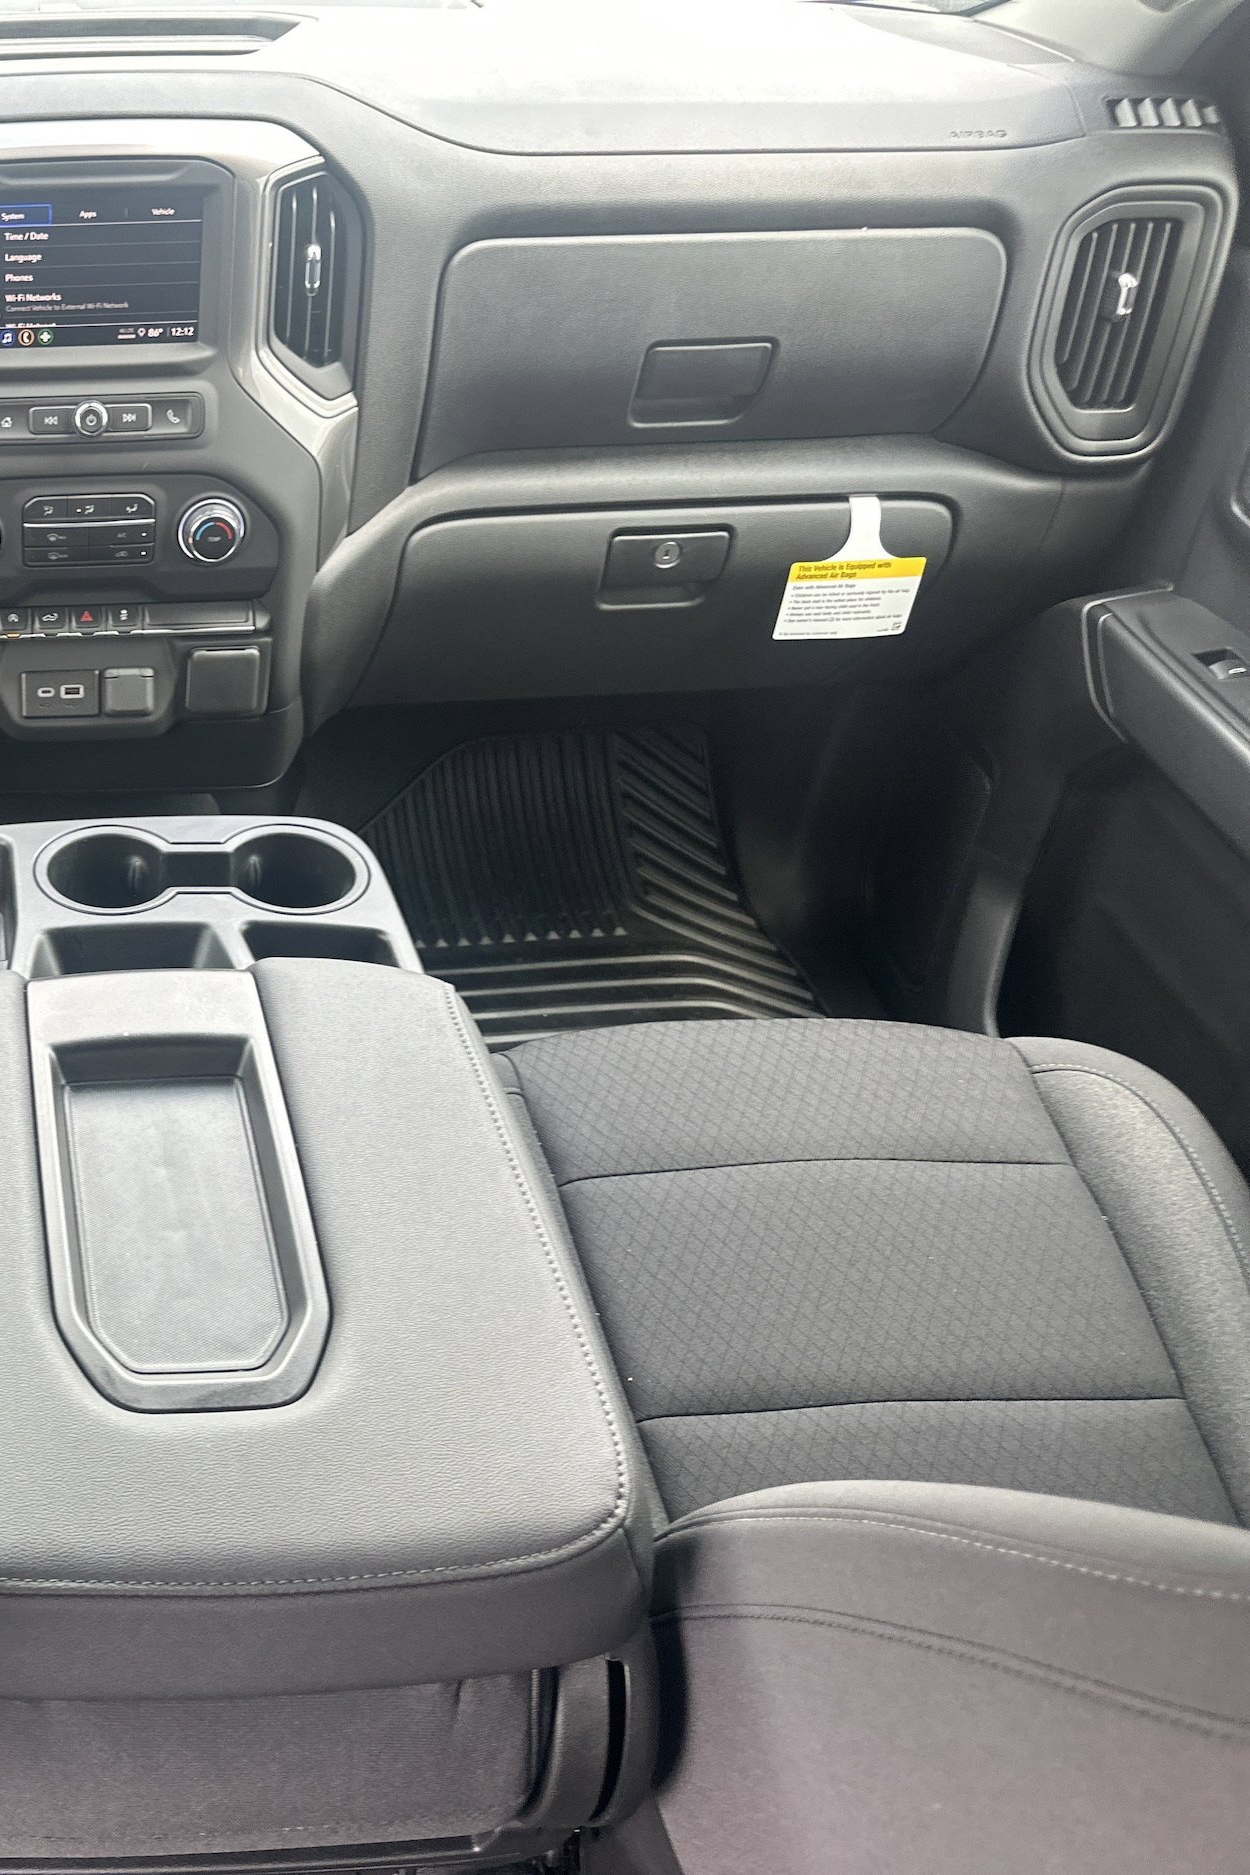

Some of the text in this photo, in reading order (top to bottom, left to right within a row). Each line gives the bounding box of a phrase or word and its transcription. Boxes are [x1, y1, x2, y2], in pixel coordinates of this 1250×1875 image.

[0, 207, 175, 221] System Apps Vehicle
[4, 232, 23, 240] Time
[29, 231, 49, 240] Date
[4, 253, 42, 263] Language
[4, 273, 34, 282] Phones
[4, 292, 62, 302] Wi-Fi Networks
[170, 326, 195, 336] 12:12
[813, 564, 837, 572] Vehicle
[845, 561, 876, 571] Equipped
[877, 561, 892, 569] with
[795, 572, 828, 580] Advanced
[840, 570, 857, 579] Bags
